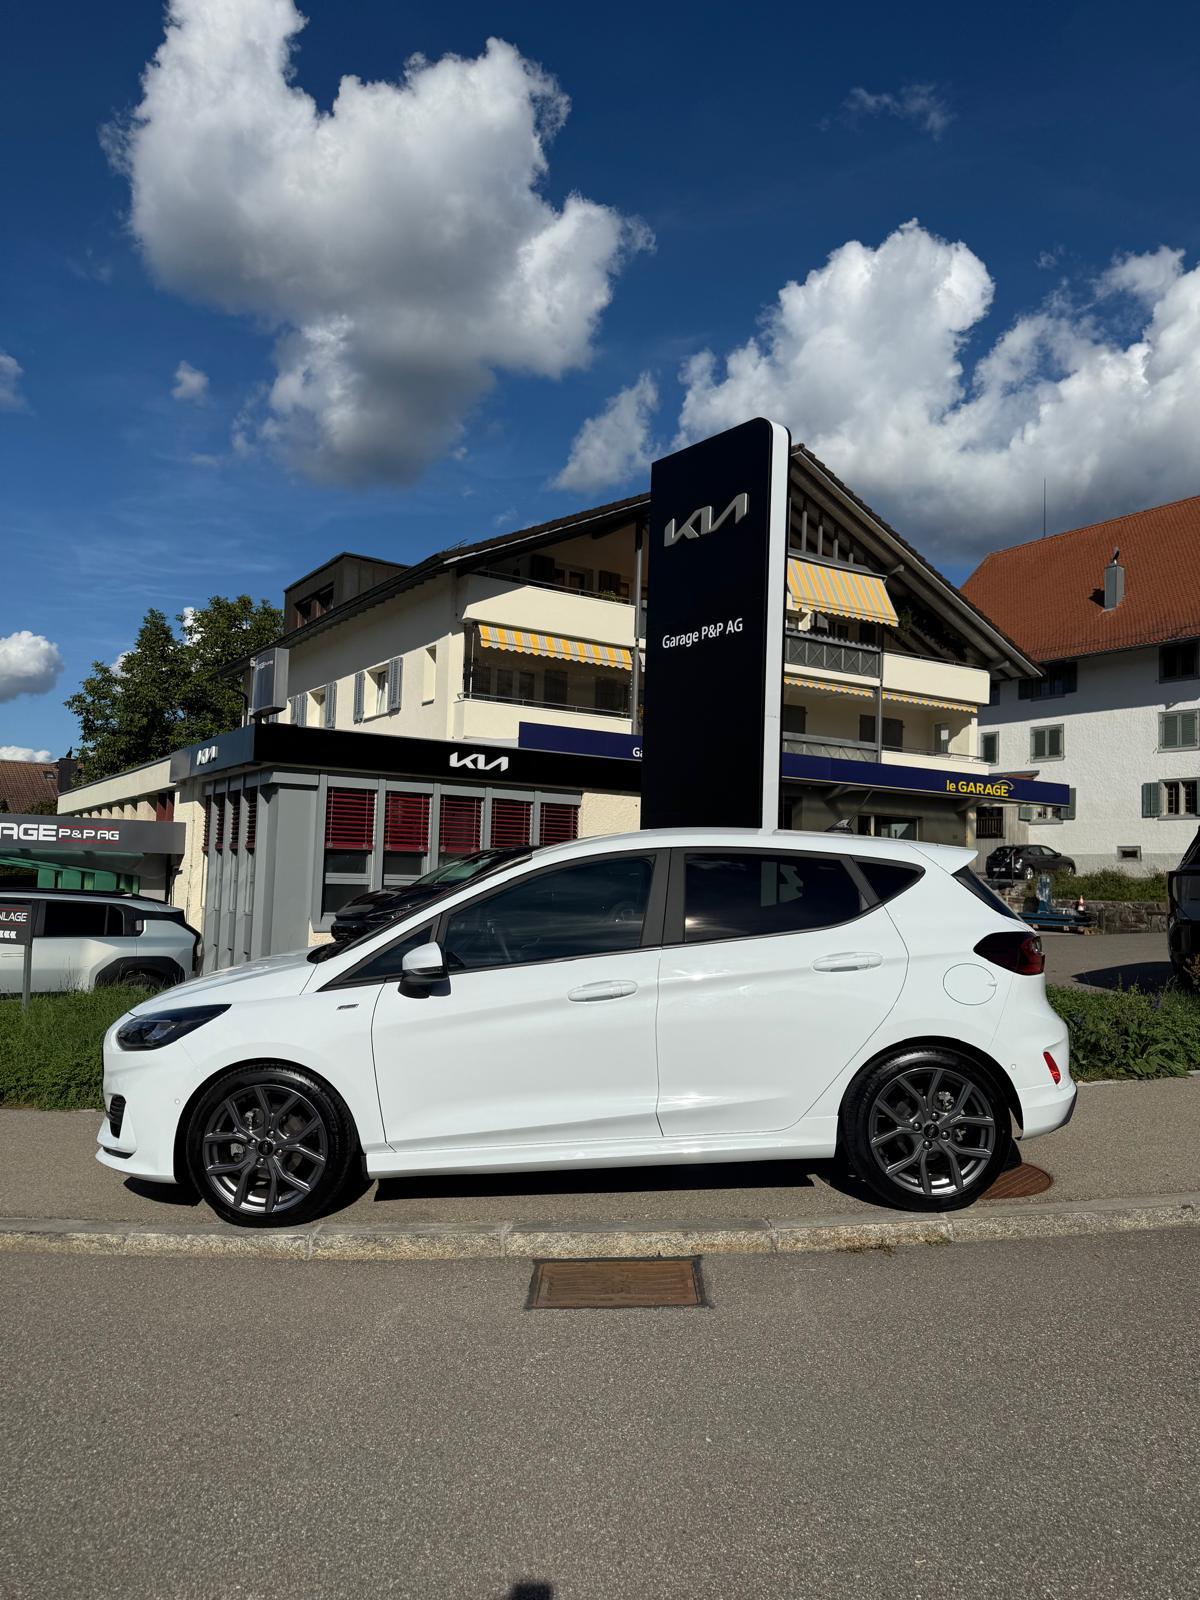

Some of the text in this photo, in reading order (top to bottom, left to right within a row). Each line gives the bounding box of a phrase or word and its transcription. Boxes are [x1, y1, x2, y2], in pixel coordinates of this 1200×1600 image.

[664, 492, 749, 547] KIA
[662, 617, 743, 649] Garage P&P AG
[449, 751, 509, 772] KIA
[946, 779, 1009, 797] le GARAGE
[0, 822, 120, 841] AGE P&P AG
